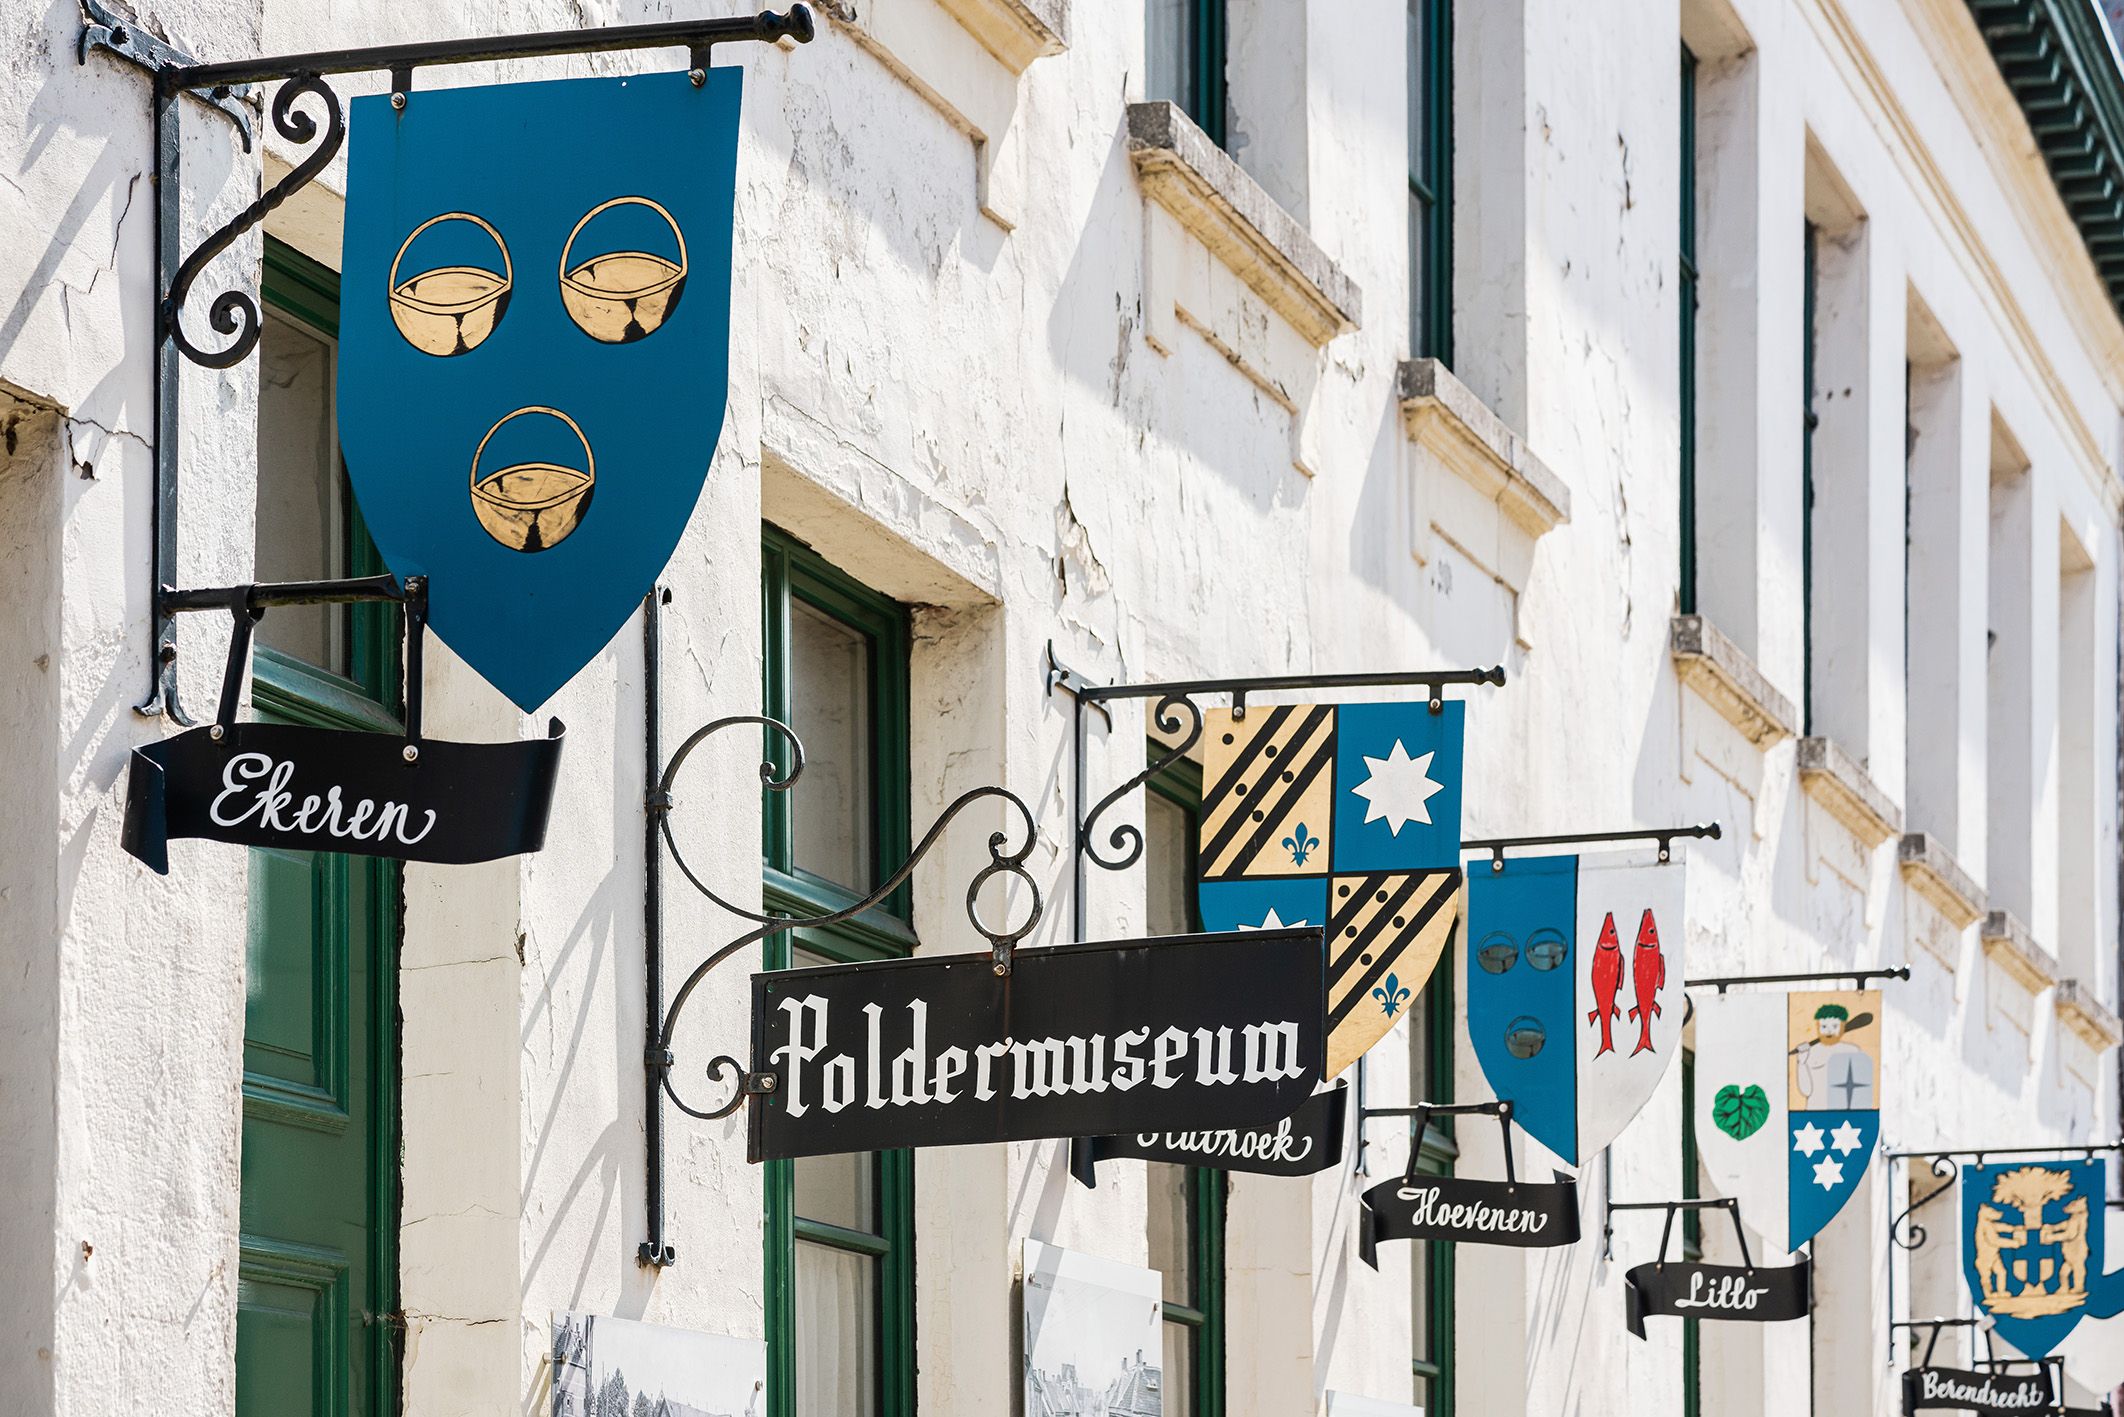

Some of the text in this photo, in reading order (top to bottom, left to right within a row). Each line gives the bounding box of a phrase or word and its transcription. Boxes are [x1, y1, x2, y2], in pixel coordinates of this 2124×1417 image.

[209, 752, 437, 845] Ekeren
[770, 994, 1307, 1118] Poldermuseum
[1397, 1187, 1548, 1234] Hoevenen
[1675, 1271, 1770, 1310] Lillo
[1922, 1371, 2044, 1408] Berendrecht
